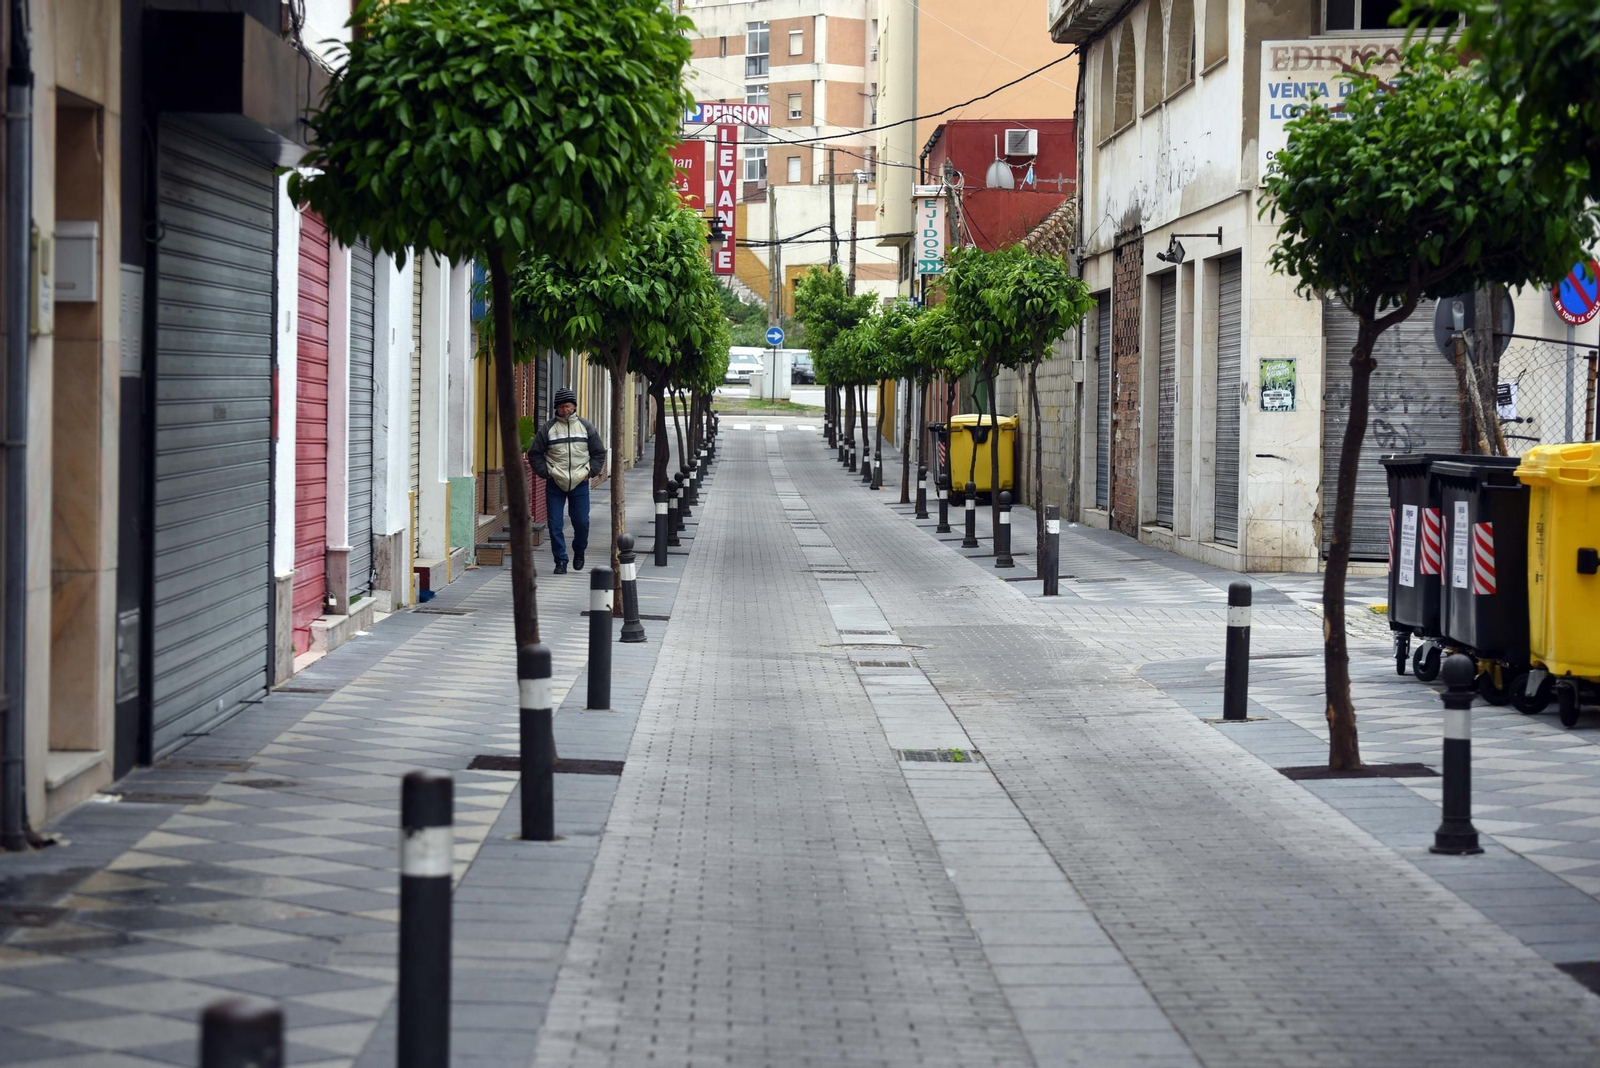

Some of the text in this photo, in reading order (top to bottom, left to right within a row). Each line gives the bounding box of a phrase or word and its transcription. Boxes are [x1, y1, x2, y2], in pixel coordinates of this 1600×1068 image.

[1268, 82, 1330, 98] VENTA
[703, 105, 769, 124] PENSION
[718, 128, 734, 269] LEVANTE
[923, 199, 940, 259] EJIDOS
[1555, 300, 1562, 311] EN
[1562, 310, 1575, 322] TODA
